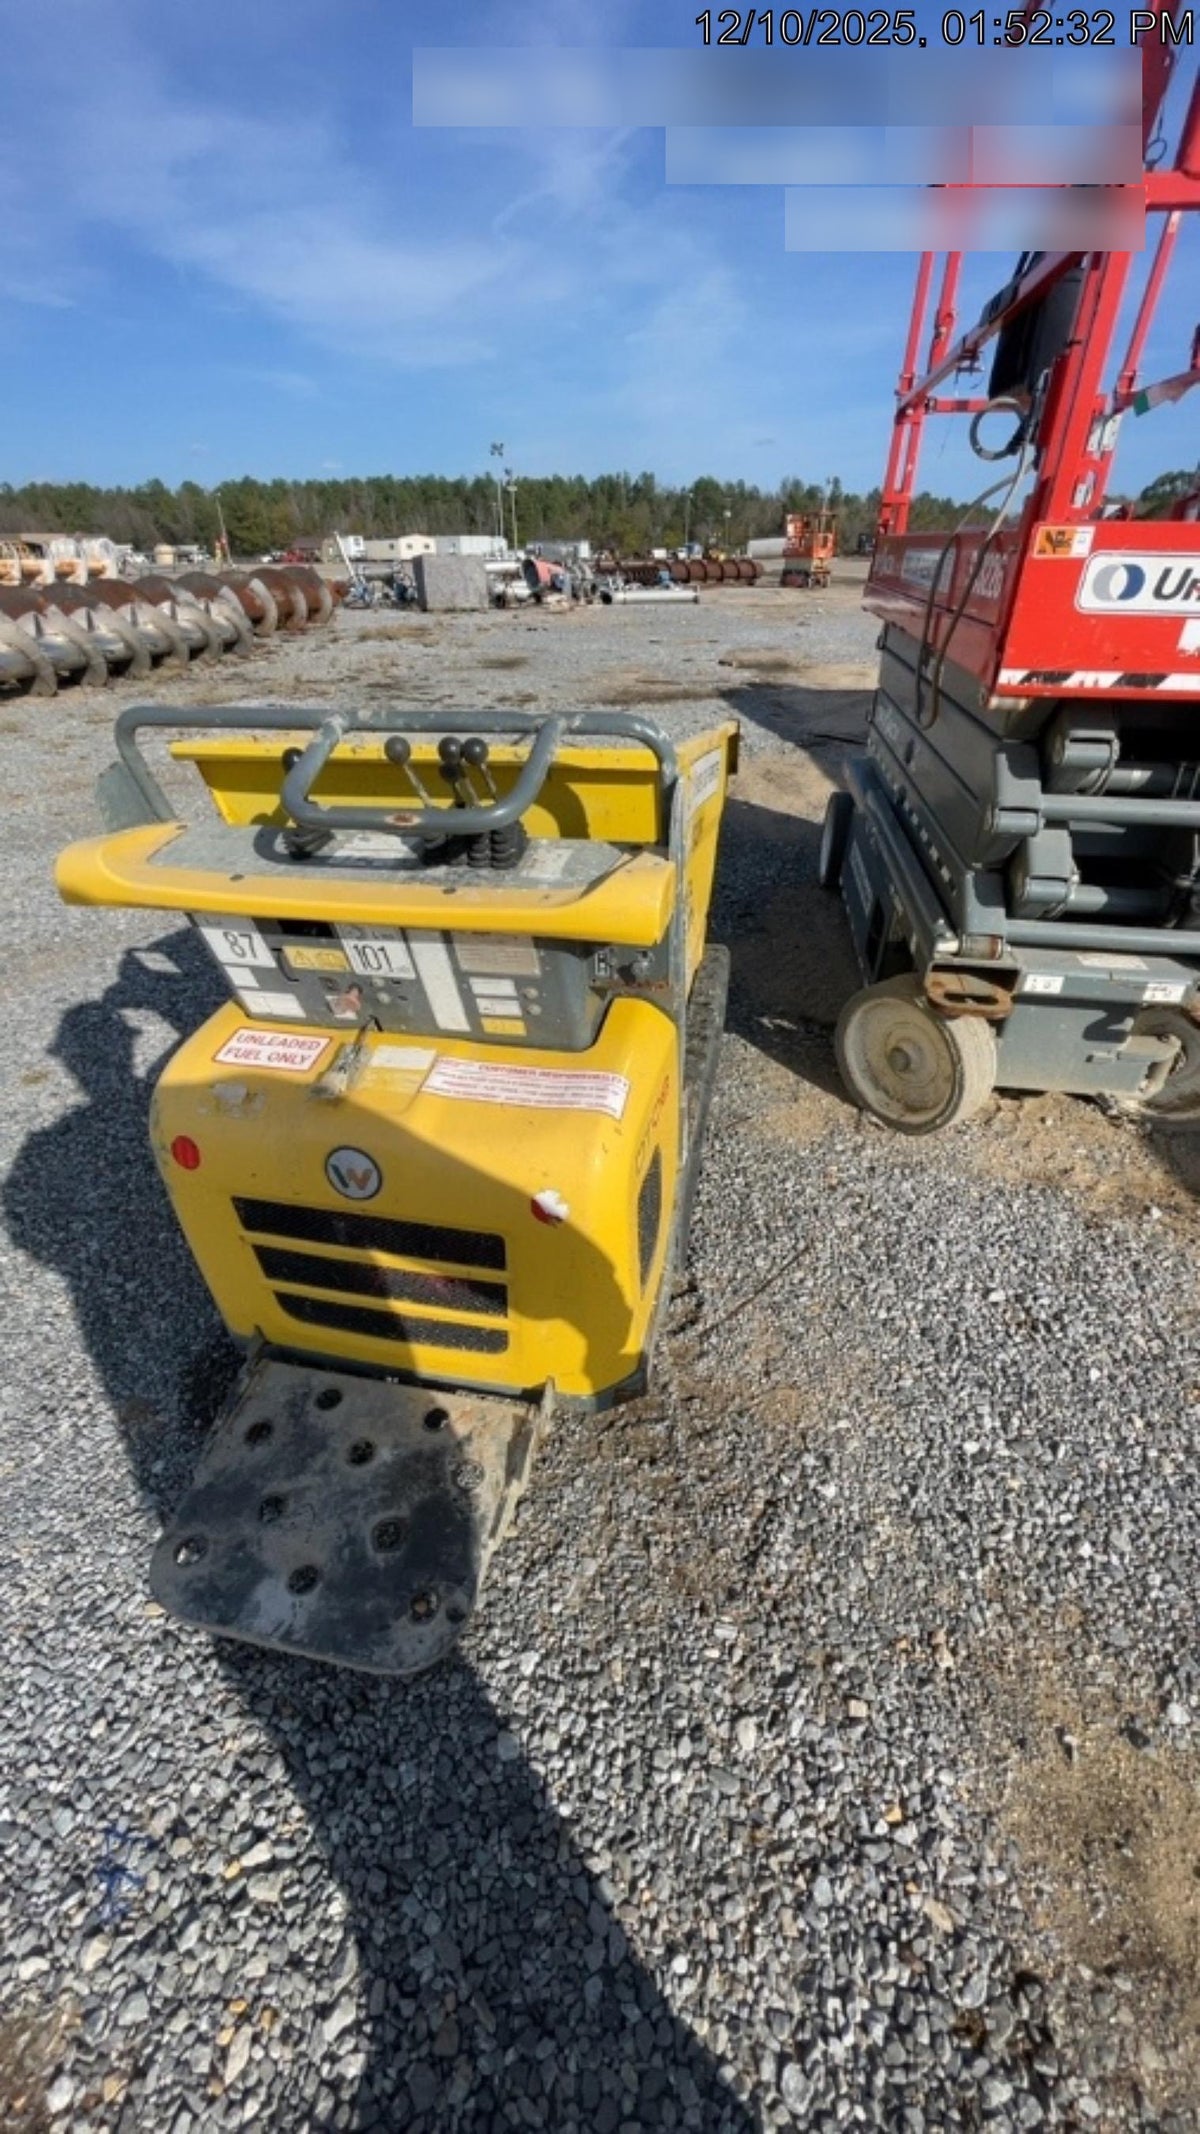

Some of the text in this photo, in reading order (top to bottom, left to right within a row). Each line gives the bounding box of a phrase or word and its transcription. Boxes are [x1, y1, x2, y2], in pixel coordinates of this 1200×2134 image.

[223, 931, 257, 958] 87
[353, 944, 394, 972] 101
[236, 1033, 321, 1050] UNLEADED
[224, 1046, 312, 1065] FUEL ONLY
